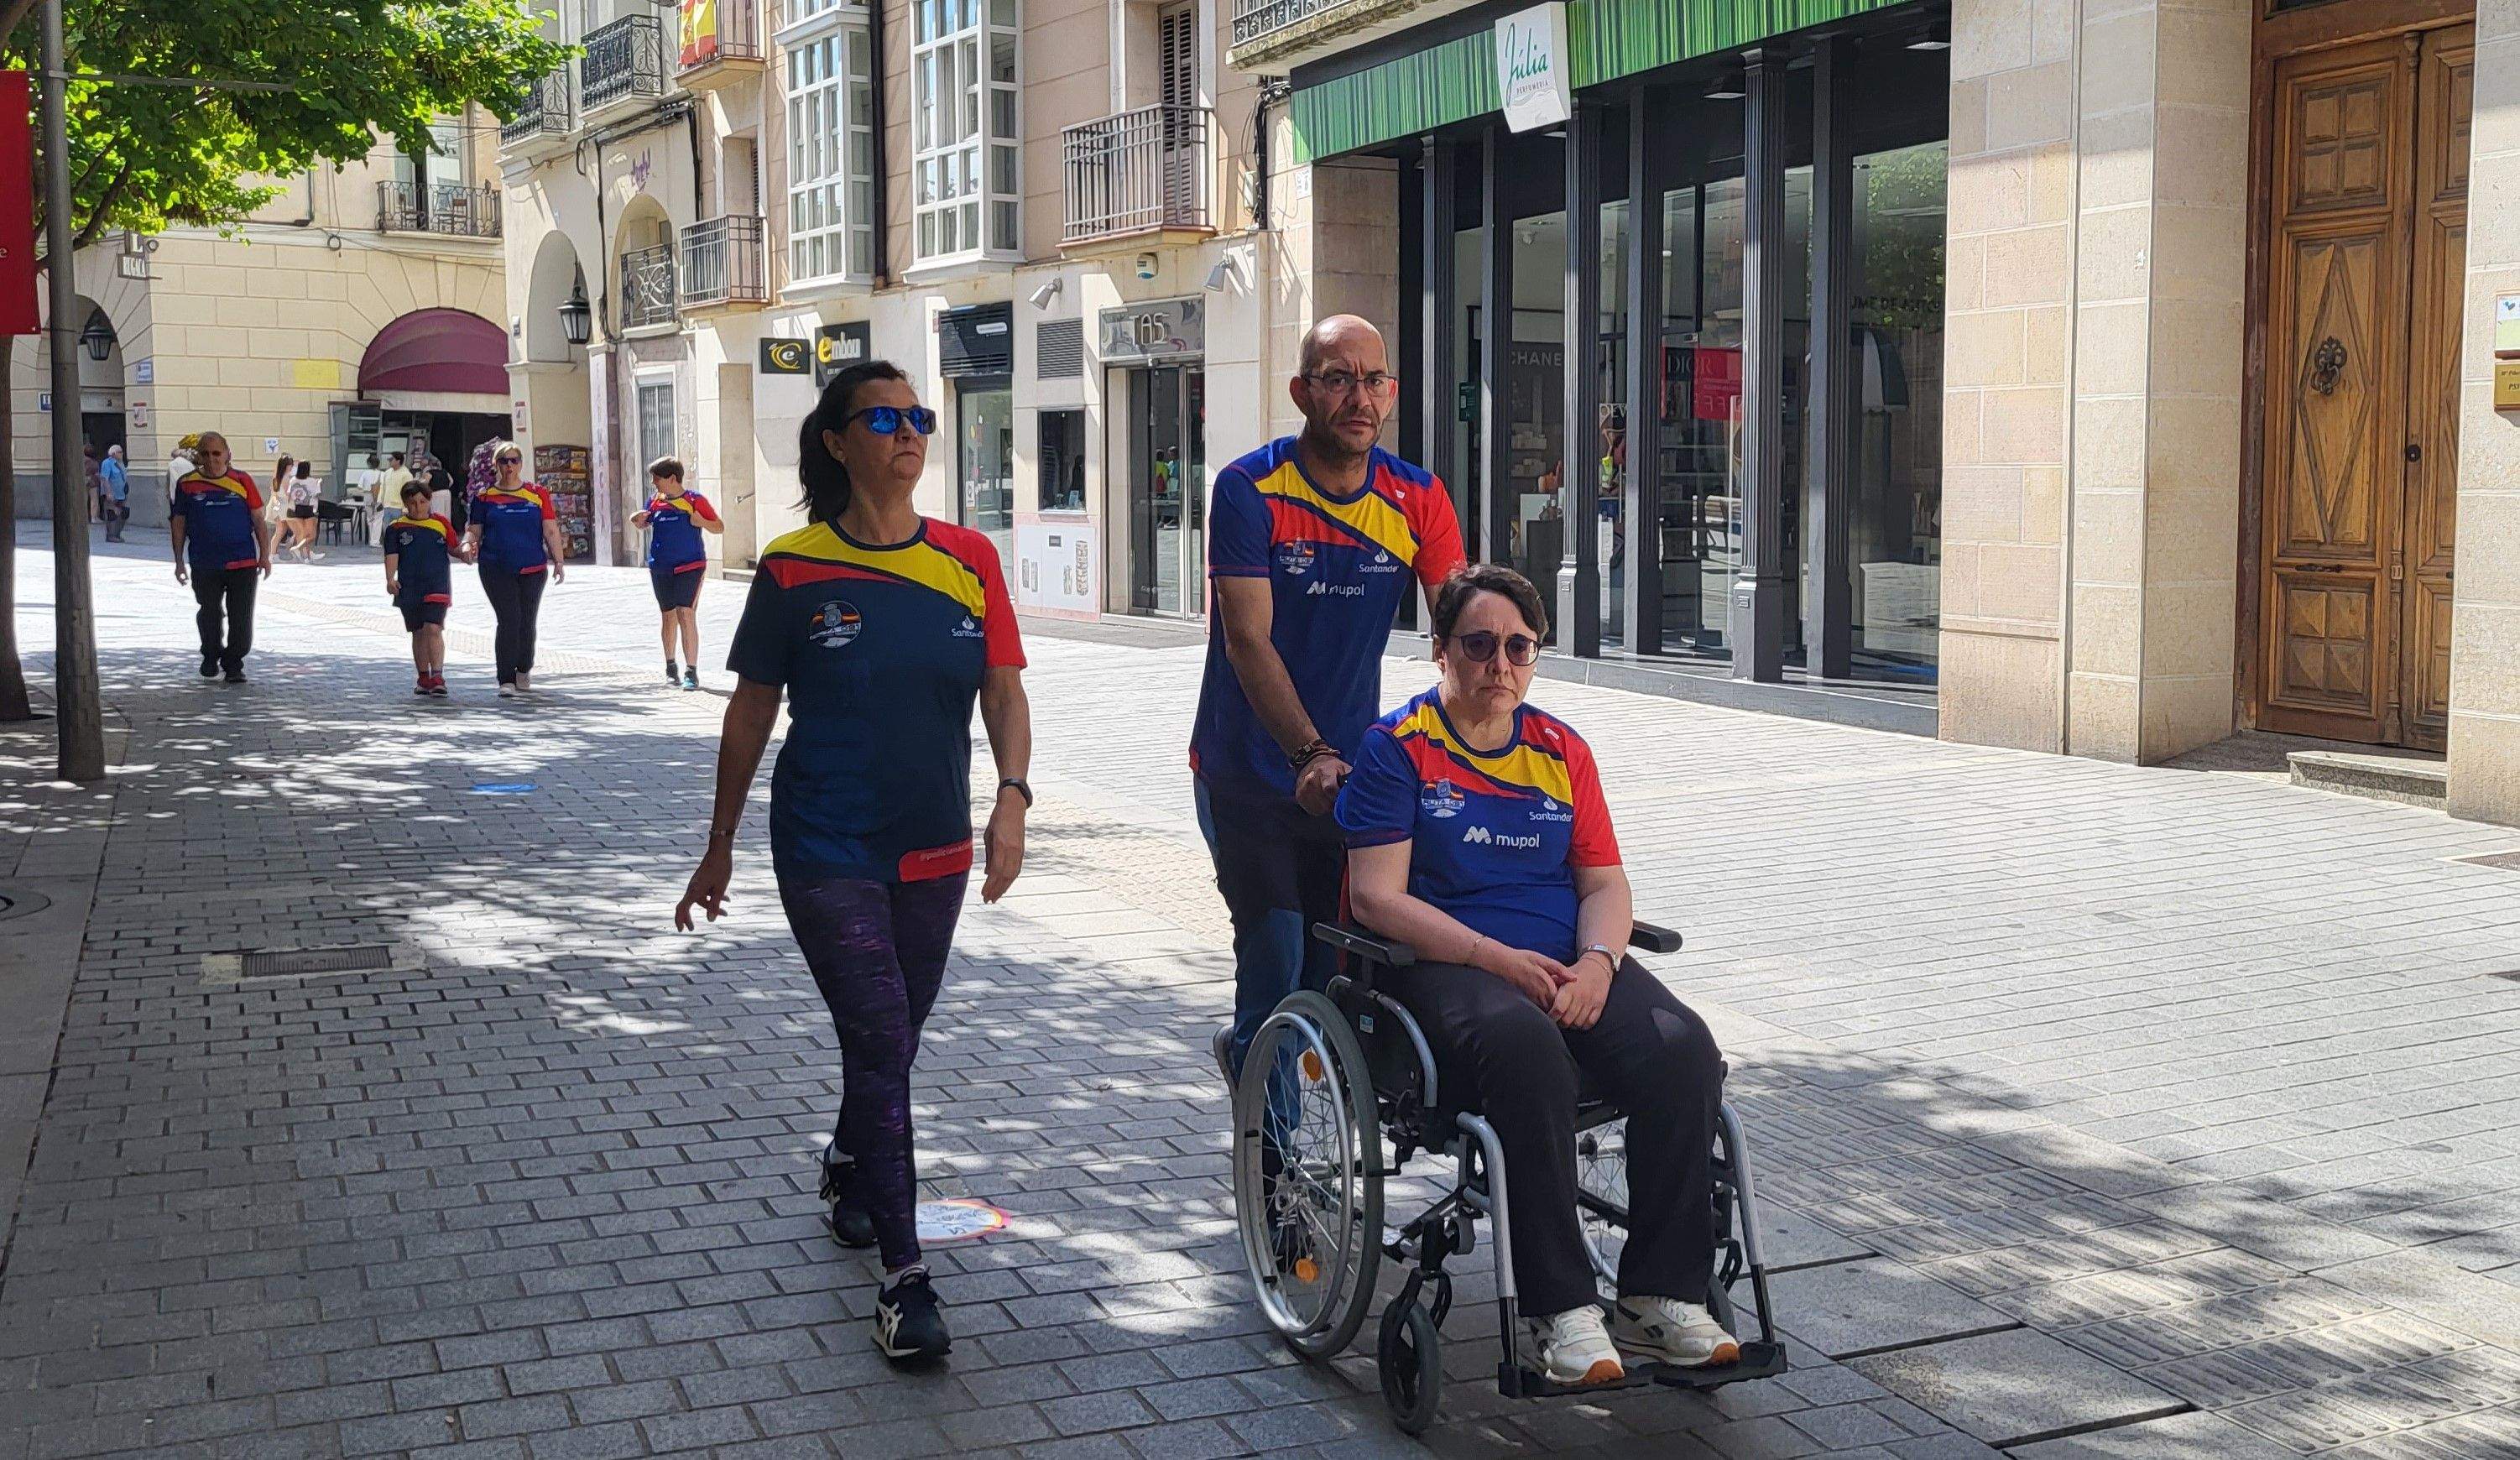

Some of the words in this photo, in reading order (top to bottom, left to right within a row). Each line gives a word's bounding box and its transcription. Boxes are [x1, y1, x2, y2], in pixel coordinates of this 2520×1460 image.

[1505, 23, 1549, 107] Júlia
[1359, 564, 1400, 573] Santander
[1328, 583, 1365, 598] mupol
[951, 628, 984, 638] Santa
[1529, 811, 1573, 823] Santander
[1495, 833, 1541, 850] mupol
